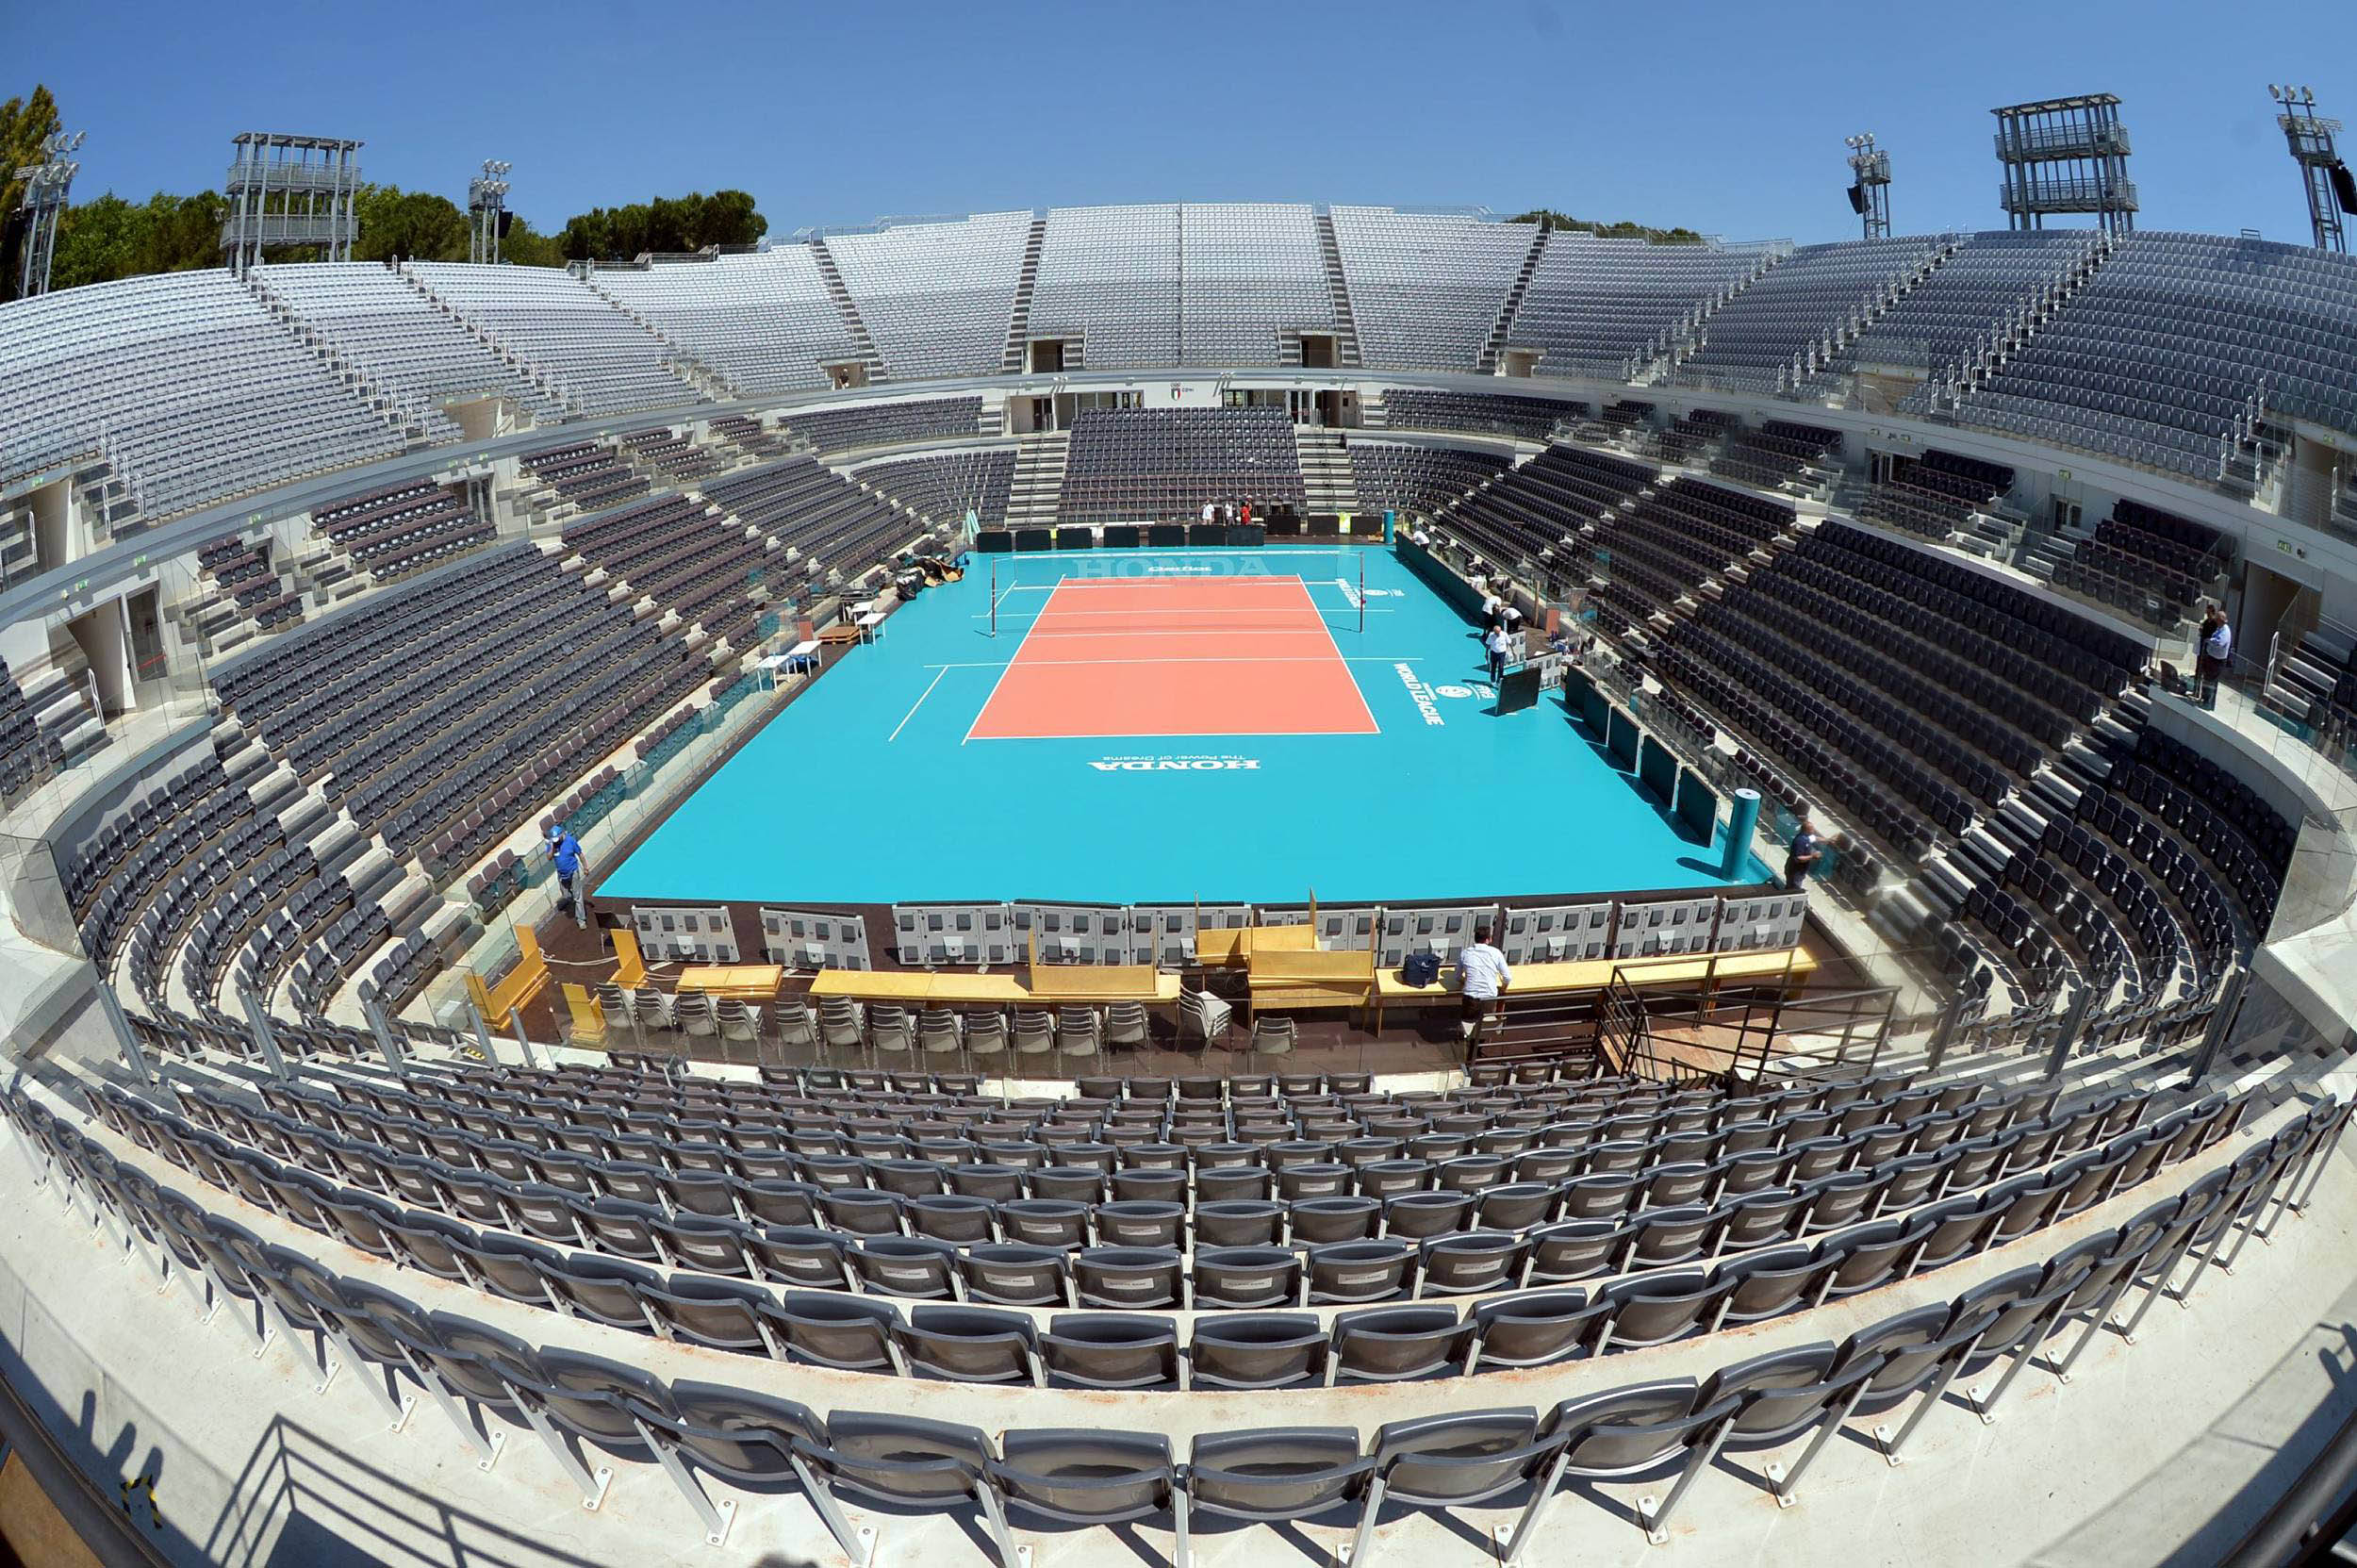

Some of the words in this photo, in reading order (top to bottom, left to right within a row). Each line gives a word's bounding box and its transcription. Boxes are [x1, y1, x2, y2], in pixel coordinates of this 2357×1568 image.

[1072, 556, 1277, 581] HONDA
[1393, 663, 1423, 690] WORLD
[1409, 689, 1445, 725] LEAGUE
[1086, 760, 1261, 771] HONDA
